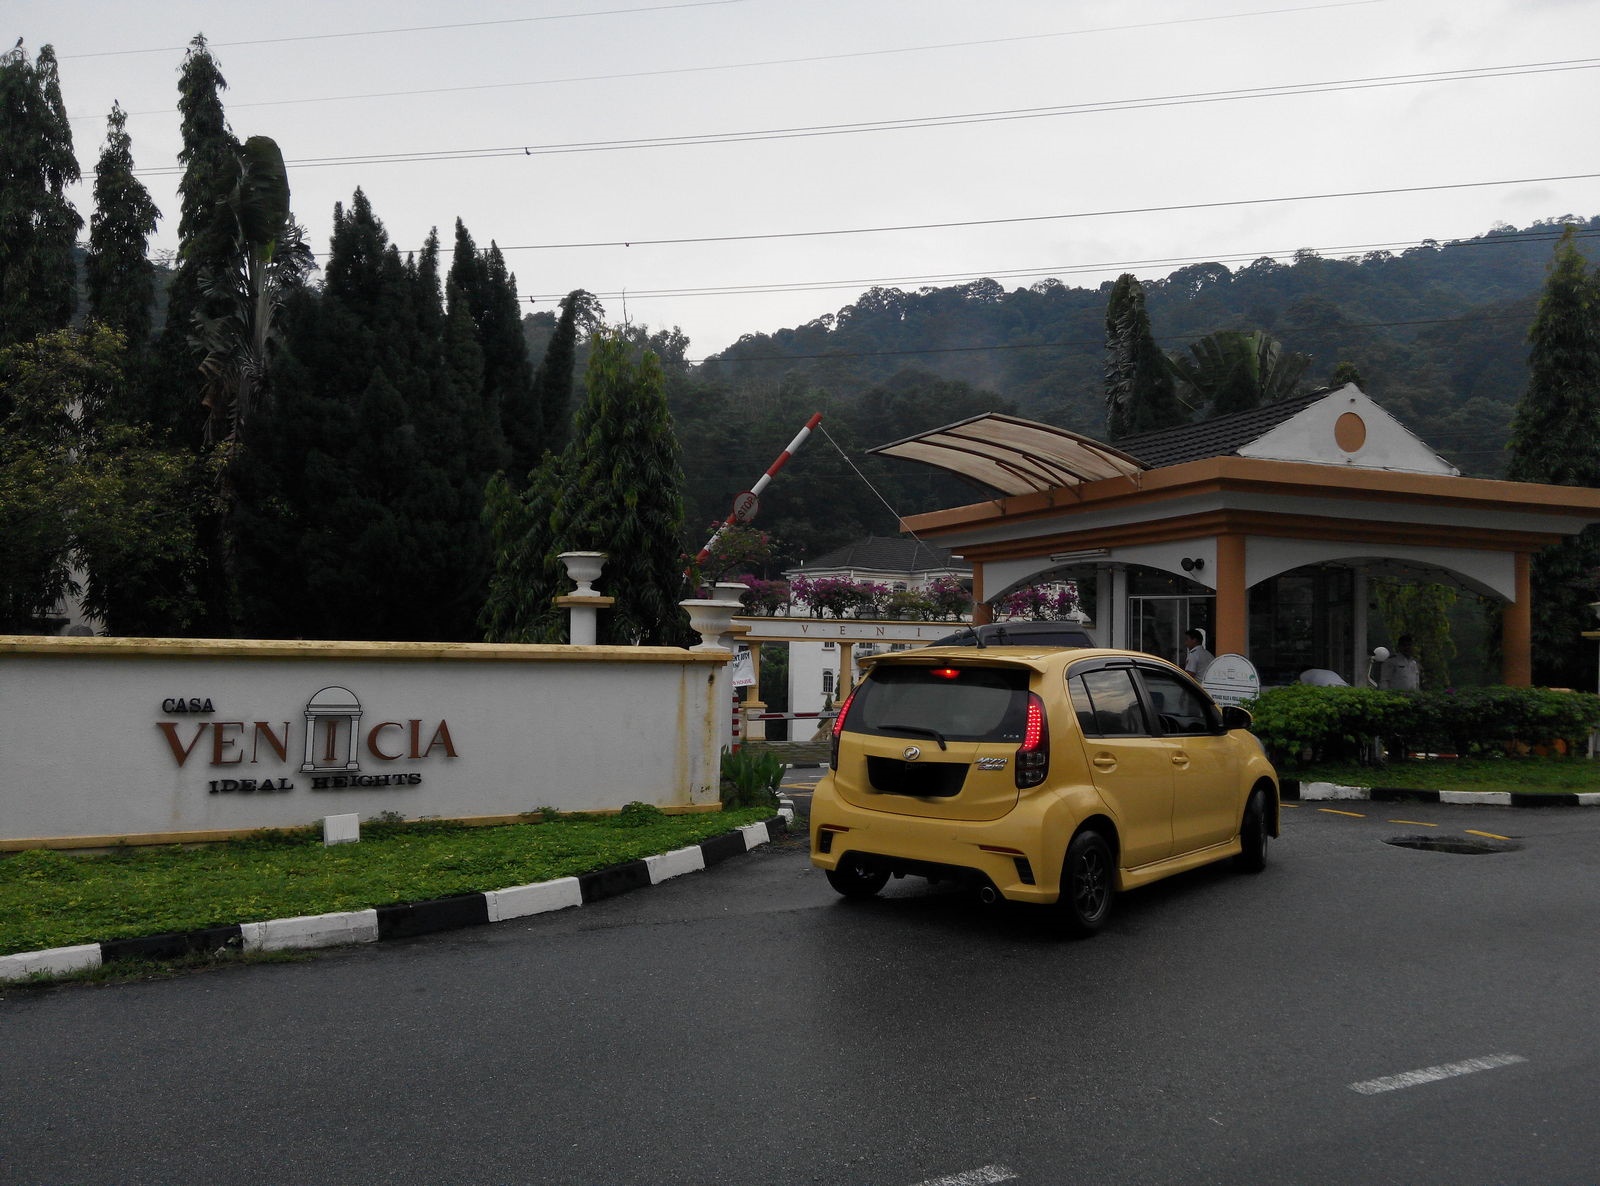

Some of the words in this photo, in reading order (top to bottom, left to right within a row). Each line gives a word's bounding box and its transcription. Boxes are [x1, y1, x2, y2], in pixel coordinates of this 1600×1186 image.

[738, 496, 754, 518] STOP
[162, 698, 215, 714] CASA
[209, 778, 294, 793] IDEAL
[312, 773, 422, 789] HEIGHTS
